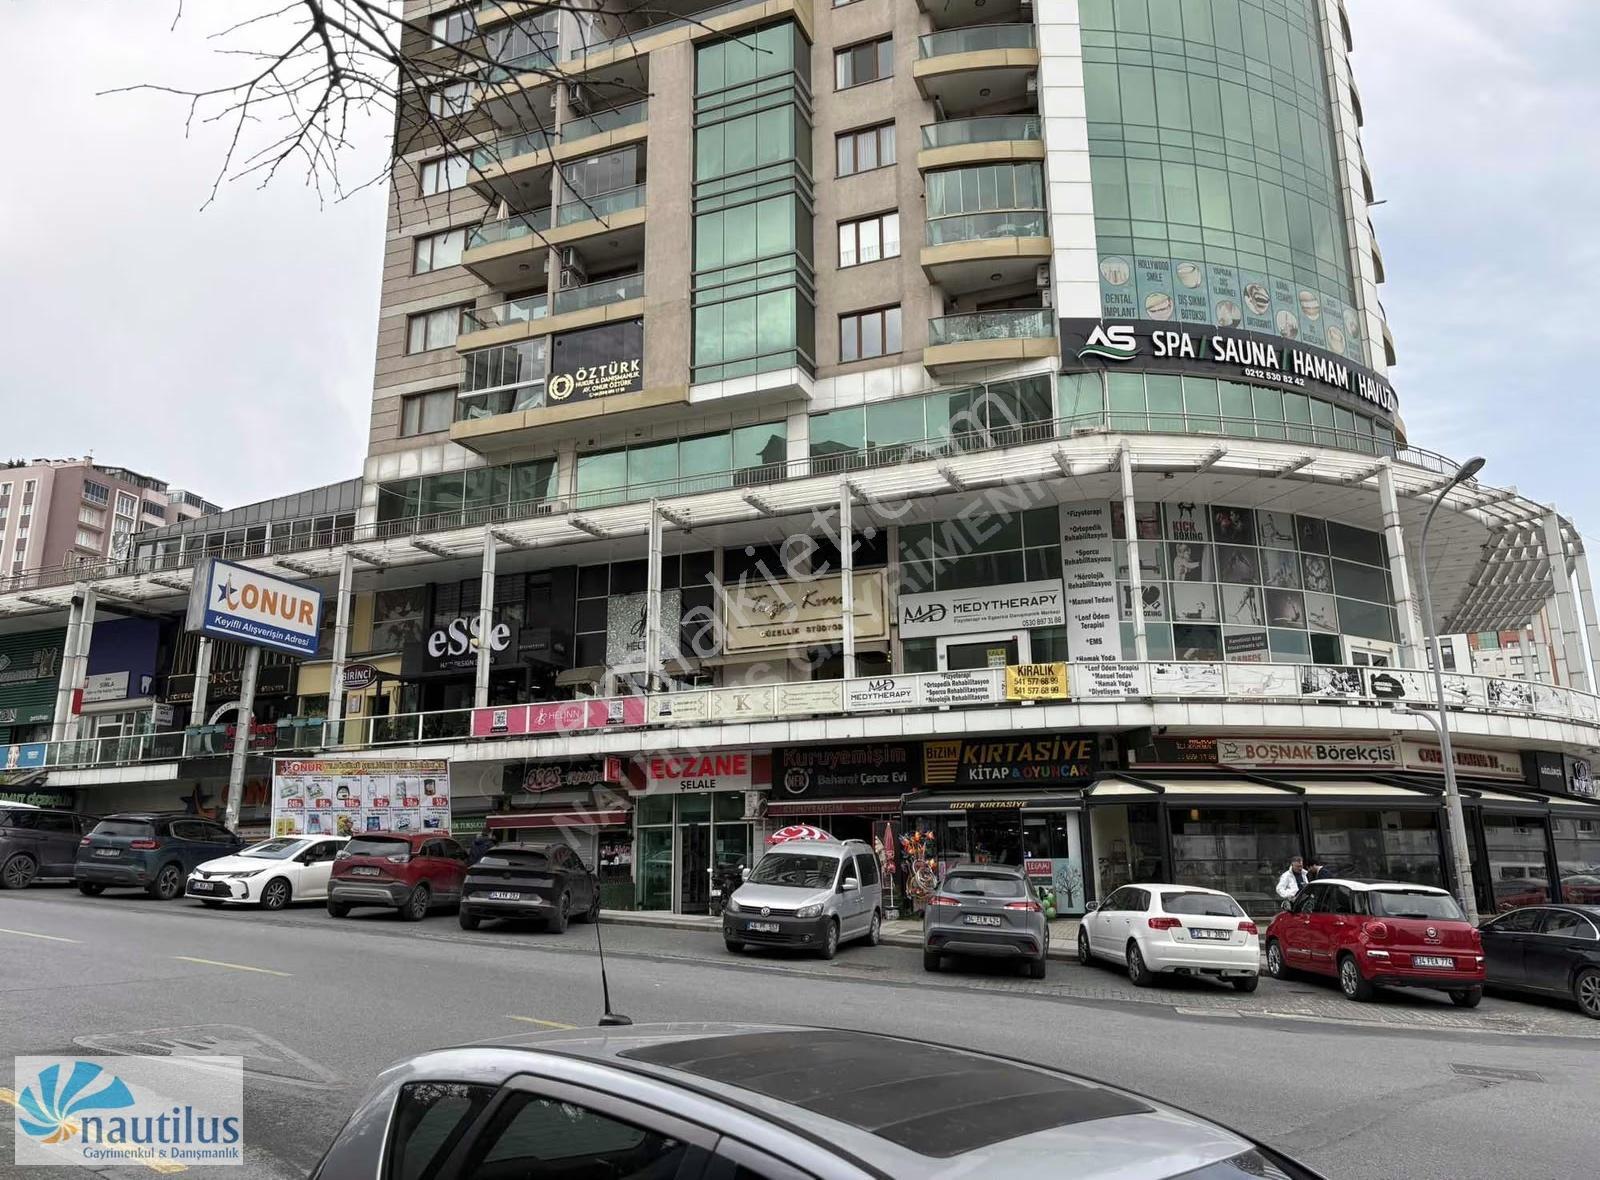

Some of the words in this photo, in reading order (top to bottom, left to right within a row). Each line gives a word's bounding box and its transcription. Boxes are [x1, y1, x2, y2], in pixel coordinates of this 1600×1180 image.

[1105, 293, 1133, 305] DENTAL
[576, 359, 641, 381] ÖZTÜRK
[1152, 330, 1196, 359] SPA
[1212, 335, 1280, 370] SAUNA
[1293, 349, 1350, 391] HAMAM
[1357, 373, 1394, 413] HAVUZ
[1245, 367, 1263, 379] 0212
[1265, 371, 1282, 382] 530
[1283, 374, 1294, 384] 82
[1294, 376, 1305, 387] 42
[610, 378, 633, 389] ÖZTÜRK
[1072, 524, 1102, 533] Ortopedik
[1172, 520, 1196, 533] KICK
[1173, 531, 1203, 541] BOXING
[241, 583, 315, 626] ONUR
[953, 594, 1058, 614] MEDYTHERAPY
[214, 614, 242, 630] Keyifli
[241, 621, 285, 640] Alışverişin
[284, 632, 310, 646] Adresi
[1081, 621, 1104, 629] Terapisi
[1089, 638, 1103, 646] EMS
[1101, 663, 1117, 671] Ödem
[926, 680, 951, 689] Ortopedik
[951, 678, 990, 688] Rehabilitasyon
[1027, 677, 1039, 685] 577
[850, 689, 913, 701] MEDYTHERAPY
[929, 688, 949, 696] Sporcu
[1027, 686, 1039, 694] 577
[1091, 688, 1120, 696] Diyetisyen
[1126, 687, 1139, 695] EMS
[951, 693, 990, 702] Rehabilitasyon
[963, 735, 1094, 764] KIRTASİYE
[1245, 744, 1313, 765] BOŞNAK
[1316, 746, 1396, 764] Börekçisi
[783, 744, 907, 769] Kuruyemişim
[293, 763, 323, 772] ONUR
[650, 752, 748, 780] ECZANE
[969, 764, 1010, 781] KİTAP
[1012, 766, 1022, 778] &
[1022, 763, 1089, 779] OYUNCAK
[817, 772, 859, 786] Baharat
[891, 772, 907, 784] Evi
[680, 778, 717, 793] ŞELALE
